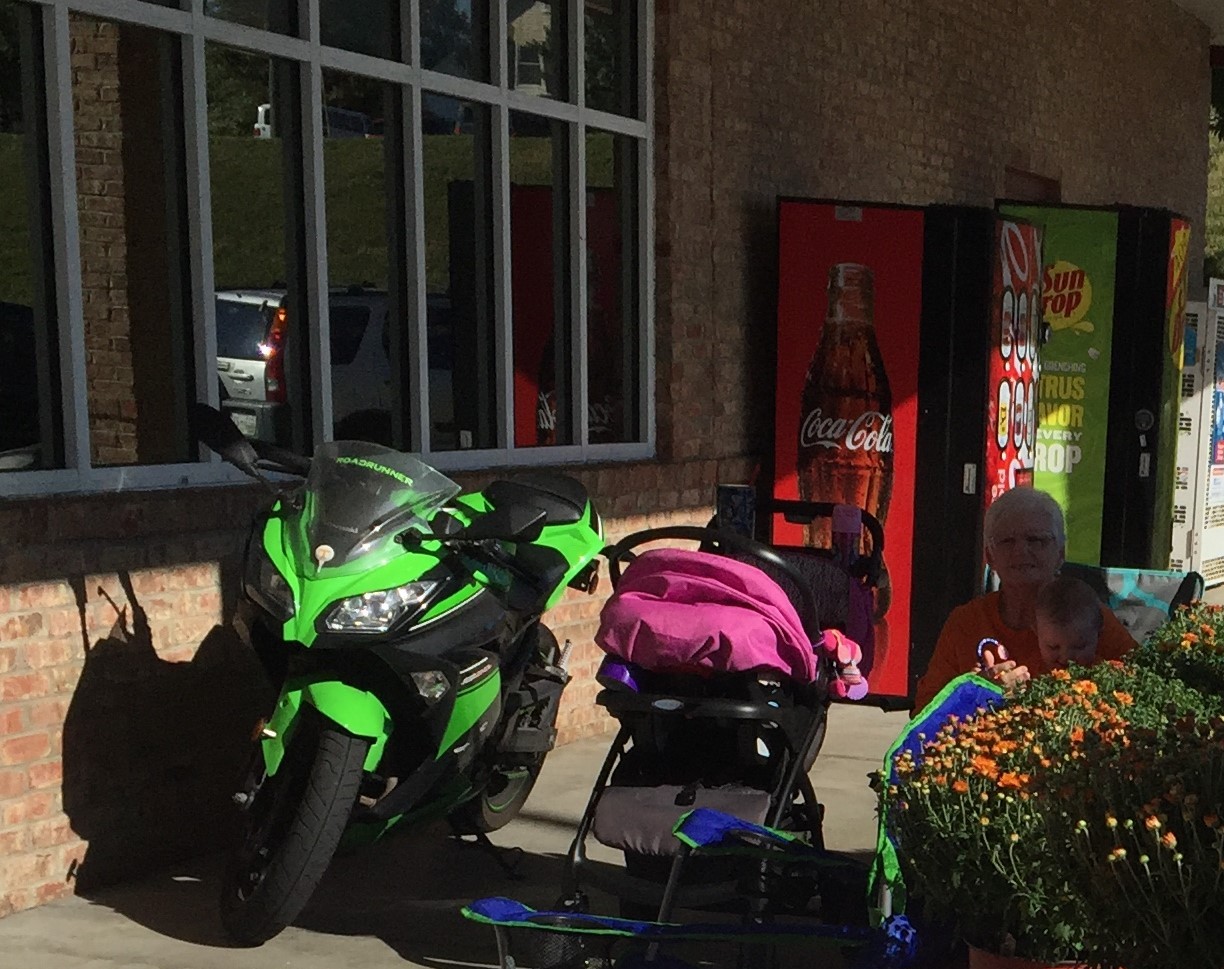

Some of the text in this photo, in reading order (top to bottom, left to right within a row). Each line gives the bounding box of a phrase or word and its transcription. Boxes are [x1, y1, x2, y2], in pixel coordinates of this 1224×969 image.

[1042, 291, 1083, 318] rop
[1040, 374, 1085, 400] TRUS
[1039, 403, 1085, 428] AVOR
[801, 408, 893, 453] Coca-Cola
[1034, 441, 1082, 473] ROP
[336, 457, 414, 487] ROADRUNNER
